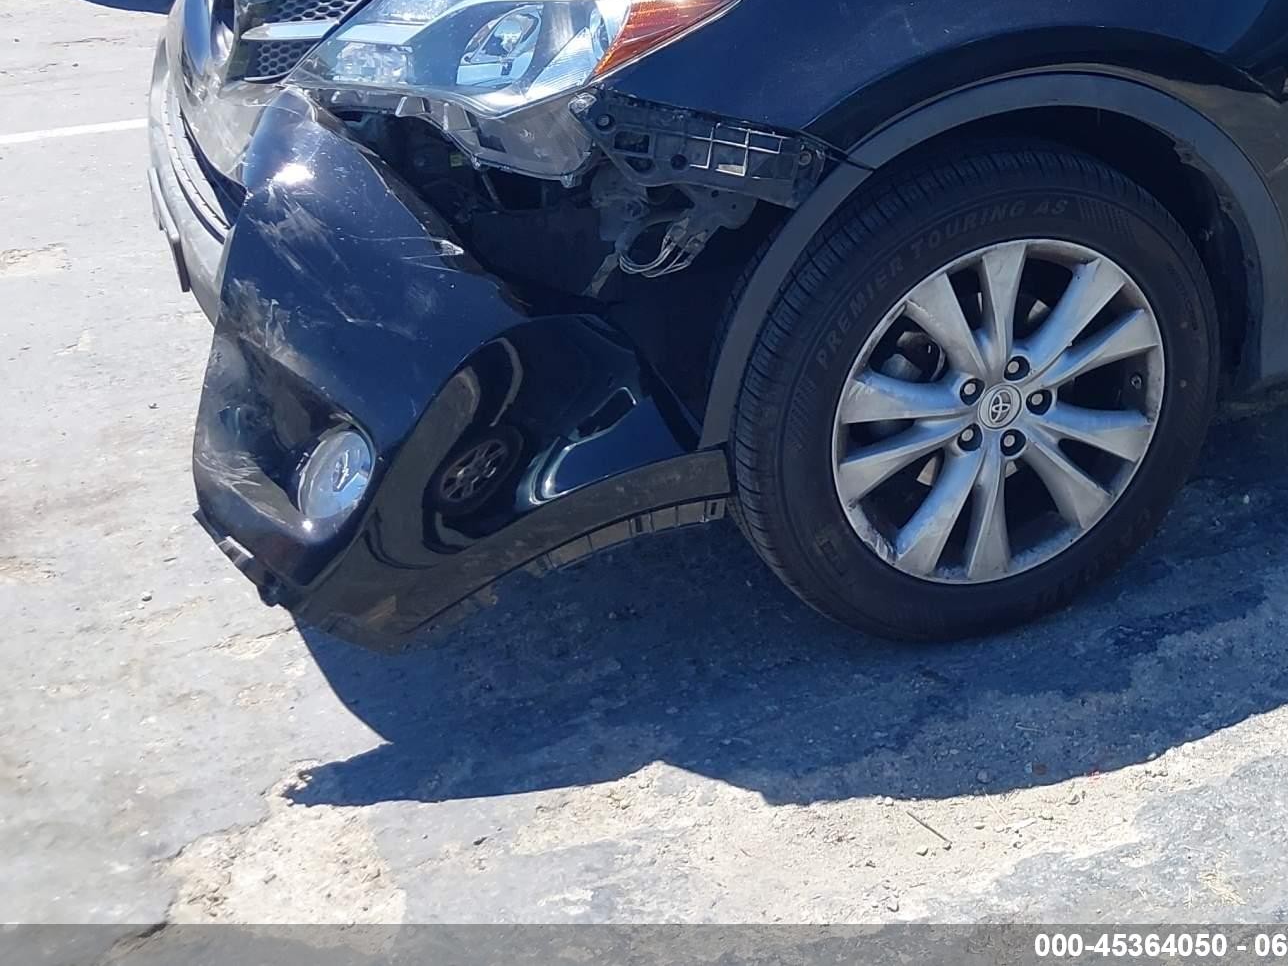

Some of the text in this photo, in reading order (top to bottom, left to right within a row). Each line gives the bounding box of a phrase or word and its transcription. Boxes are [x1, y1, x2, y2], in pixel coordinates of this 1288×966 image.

[816, 199, 1069, 367] PREMIER TOURING AS
